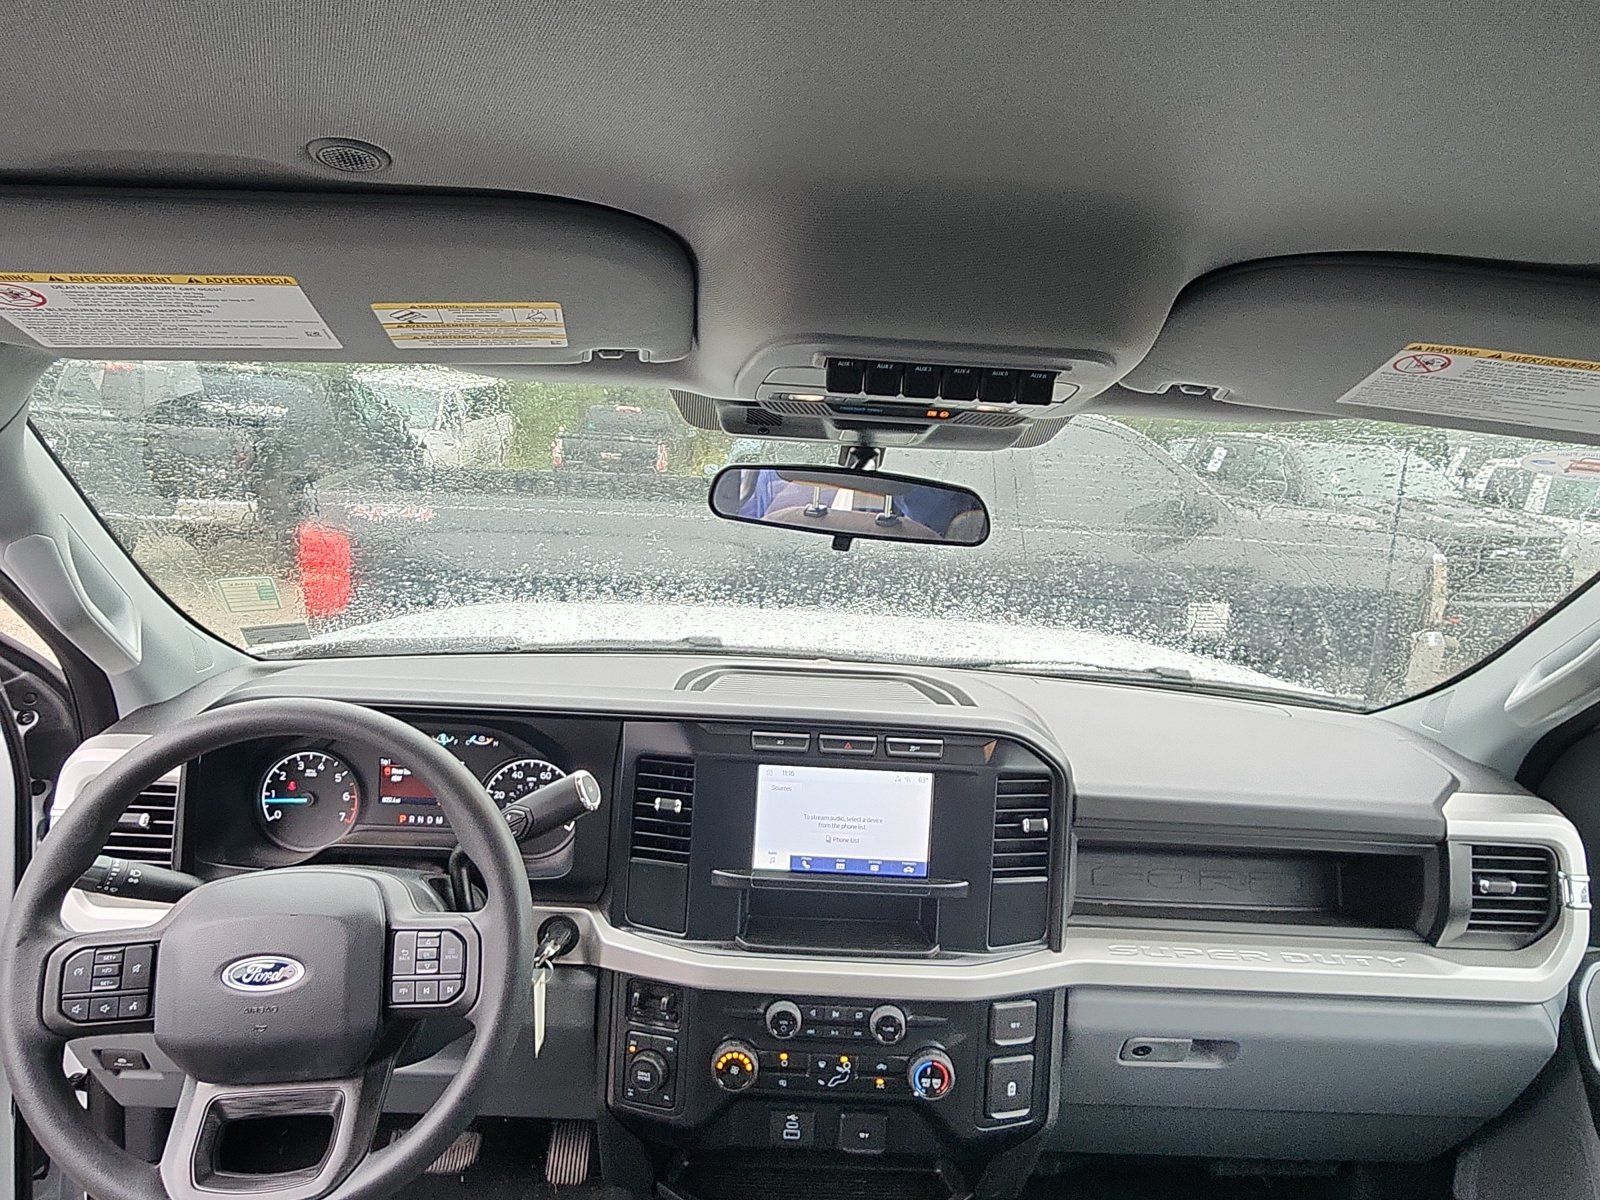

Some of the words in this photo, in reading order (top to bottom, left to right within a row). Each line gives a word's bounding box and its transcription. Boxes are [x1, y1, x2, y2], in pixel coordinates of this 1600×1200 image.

[68, 275, 173, 284] AVERTISSEMENT
[205, 277, 292, 285] ADVERTENCIA
[1425, 346, 1480, 356] WARNING
[297, 761, 305, 771] 3
[317, 762, 325, 771] 4
[279, 771, 287, 780] 2
[334, 773, 342, 783] 5
[511, 771, 524, 779] 40
[540, 771, 552, 780] 60
[771, 784, 793, 792] Sources
[271, 789, 276, 798] 1
[342, 792, 351, 801] 6
[493, 790, 505, 799] 20
[274, 810, 282, 819] 0
[339, 812, 346, 821] 7
[399, 814, 407, 823] P
[409, 815, 415, 824] R
[417, 815, 424, 824] N
[427, 816, 433, 825] D
[435, 816, 444, 825] M
[1107, 944, 1272, 963] SUPER
[1280, 951, 1406, 968] DUTY
[242, 962, 287, 984] Ford
